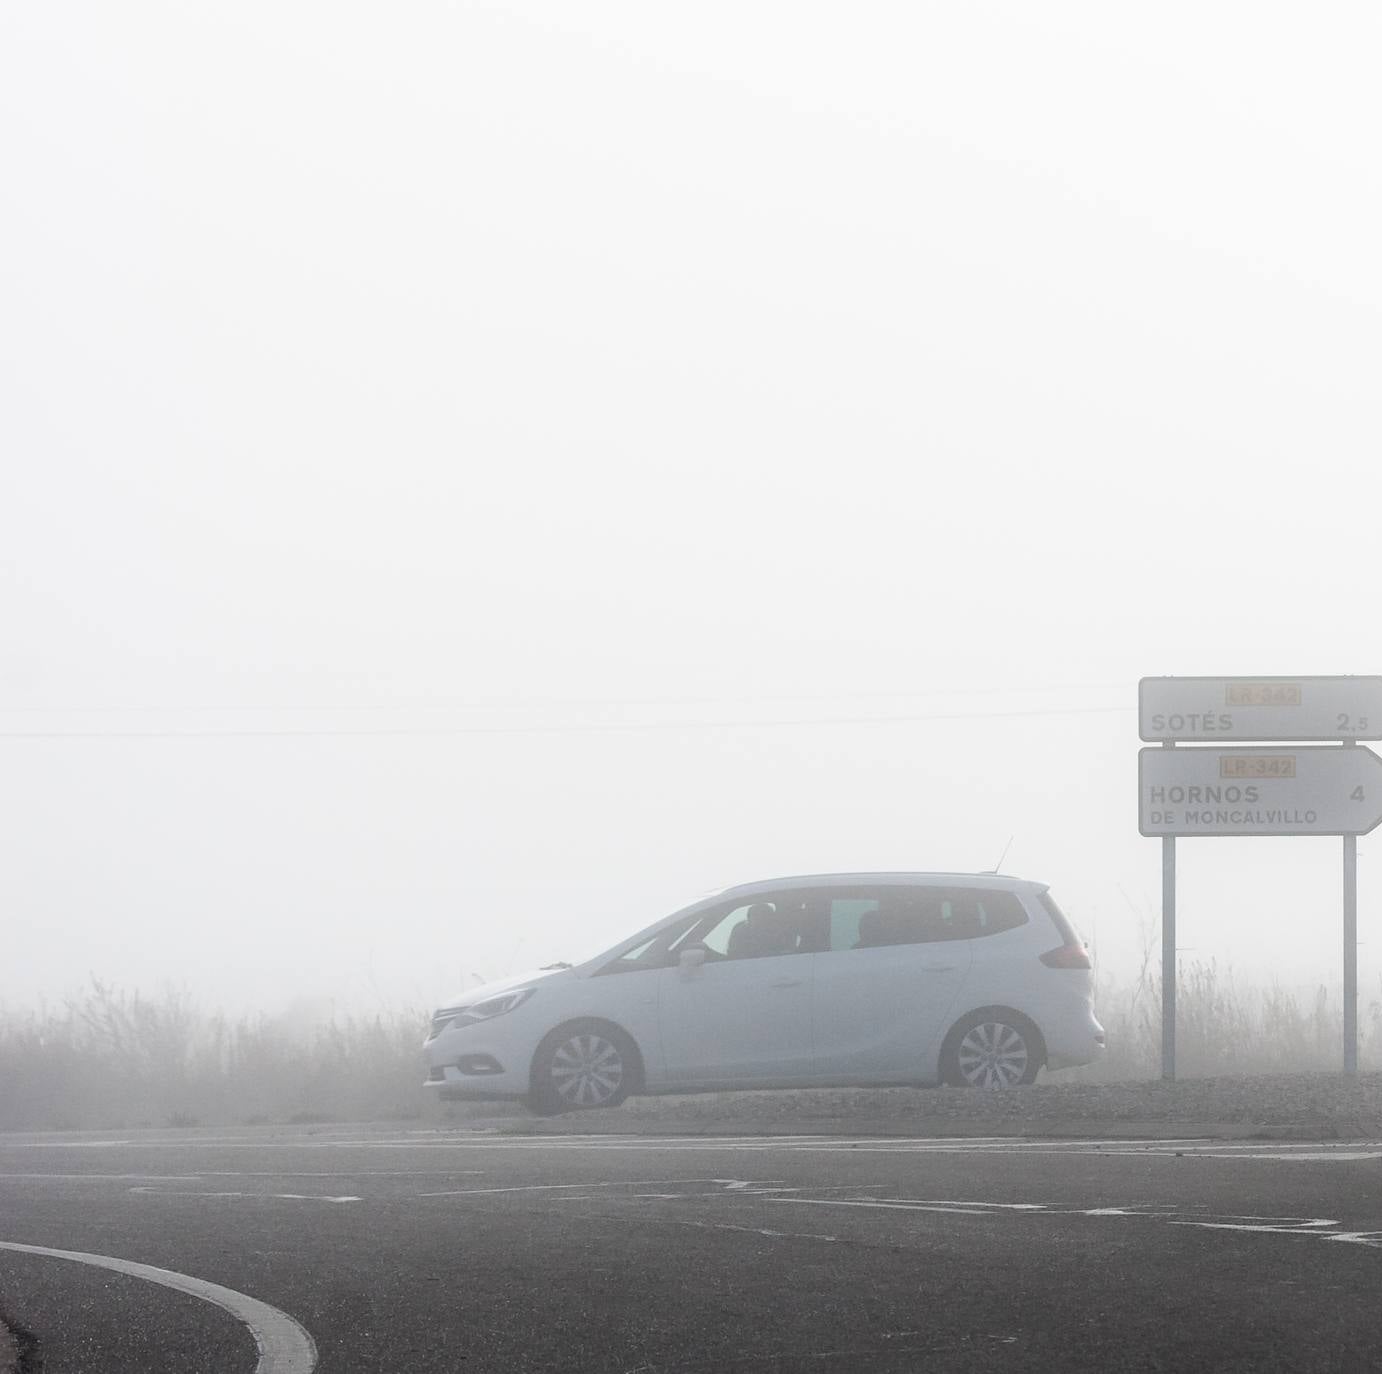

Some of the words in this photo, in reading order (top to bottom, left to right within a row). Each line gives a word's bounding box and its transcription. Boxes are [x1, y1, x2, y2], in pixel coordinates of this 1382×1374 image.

[1229, 687, 1298, 703] LR-342
[1151, 711, 1233, 732] SOTÉS
[1223, 760, 1293, 775] LR-342
[1150, 785, 1260, 804] HORNOS
[1349, 786, 1365, 803] 4
[1150, 811, 1175, 825] DE
[1185, 811, 1318, 825] MONCALVILLO
